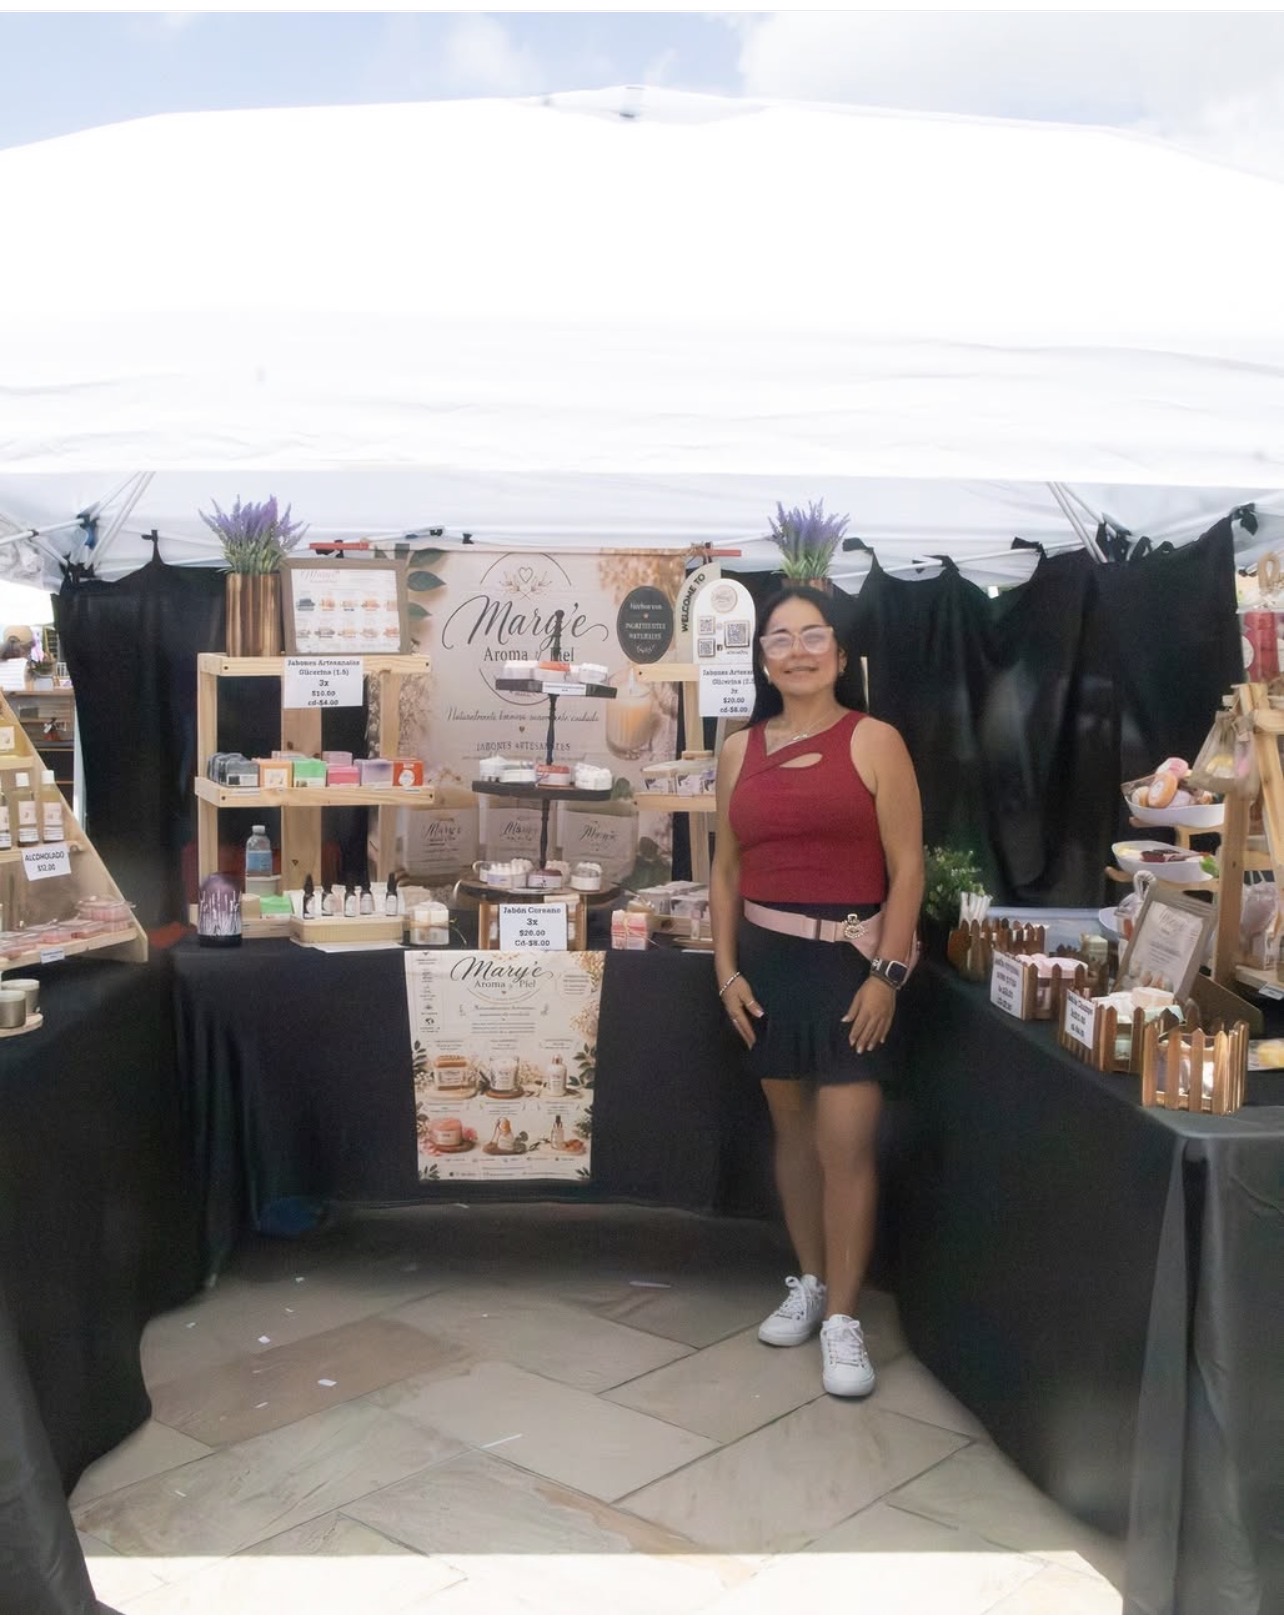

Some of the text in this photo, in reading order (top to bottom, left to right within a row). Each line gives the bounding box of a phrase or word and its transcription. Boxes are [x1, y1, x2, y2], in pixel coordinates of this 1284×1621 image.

[681, 573, 706, 632] WELCOME TO
[483, 646, 528, 662] Aroma
[319, 679, 329, 687] 3x
[25, 850, 65, 861] ALCOHOLADO
[37, 863, 56, 872] $12.00
[503, 906, 562, 914] Jabón Coreano
[526, 918, 538, 926] 3x
[519, 929, 546, 937] $20.00
[474, 980, 506, 988] Aroma
[518, 979, 537, 988] Piel
